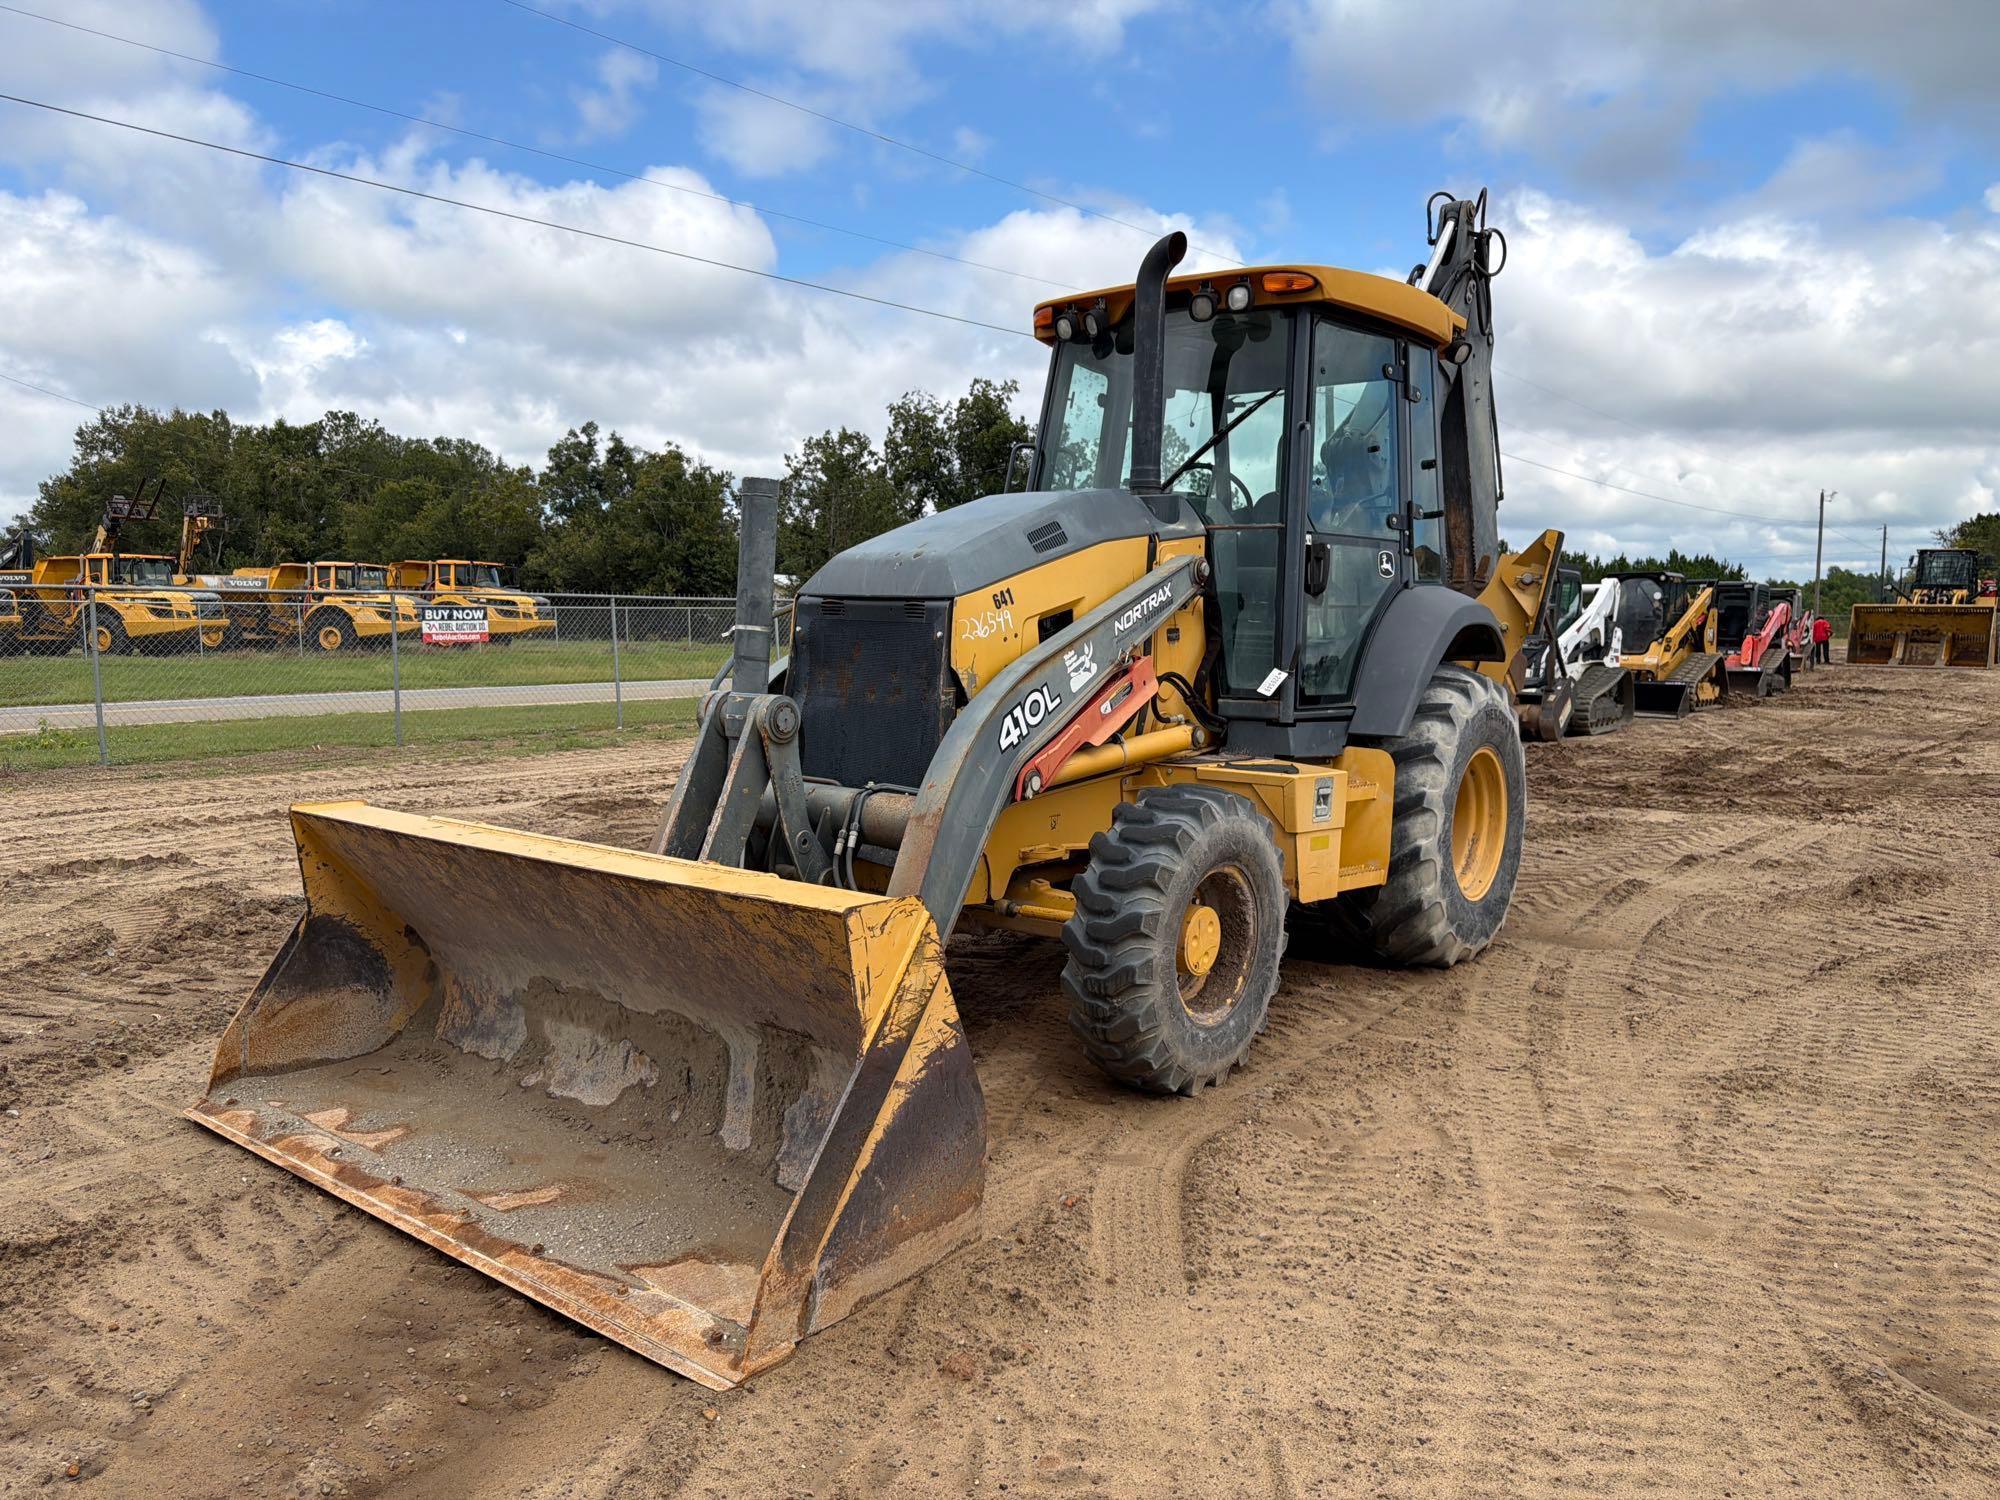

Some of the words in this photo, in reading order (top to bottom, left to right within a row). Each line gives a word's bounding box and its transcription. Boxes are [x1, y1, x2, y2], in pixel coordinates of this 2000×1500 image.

[425, 609, 449, 619] BUY
[452, 609, 483, 619] NOW
[992, 587, 1014, 610] 641
[1114, 582, 1172, 636] NORTRAX
[959, 609, 1013, 640] 226549
[998, 682, 1062, 754] 410L
